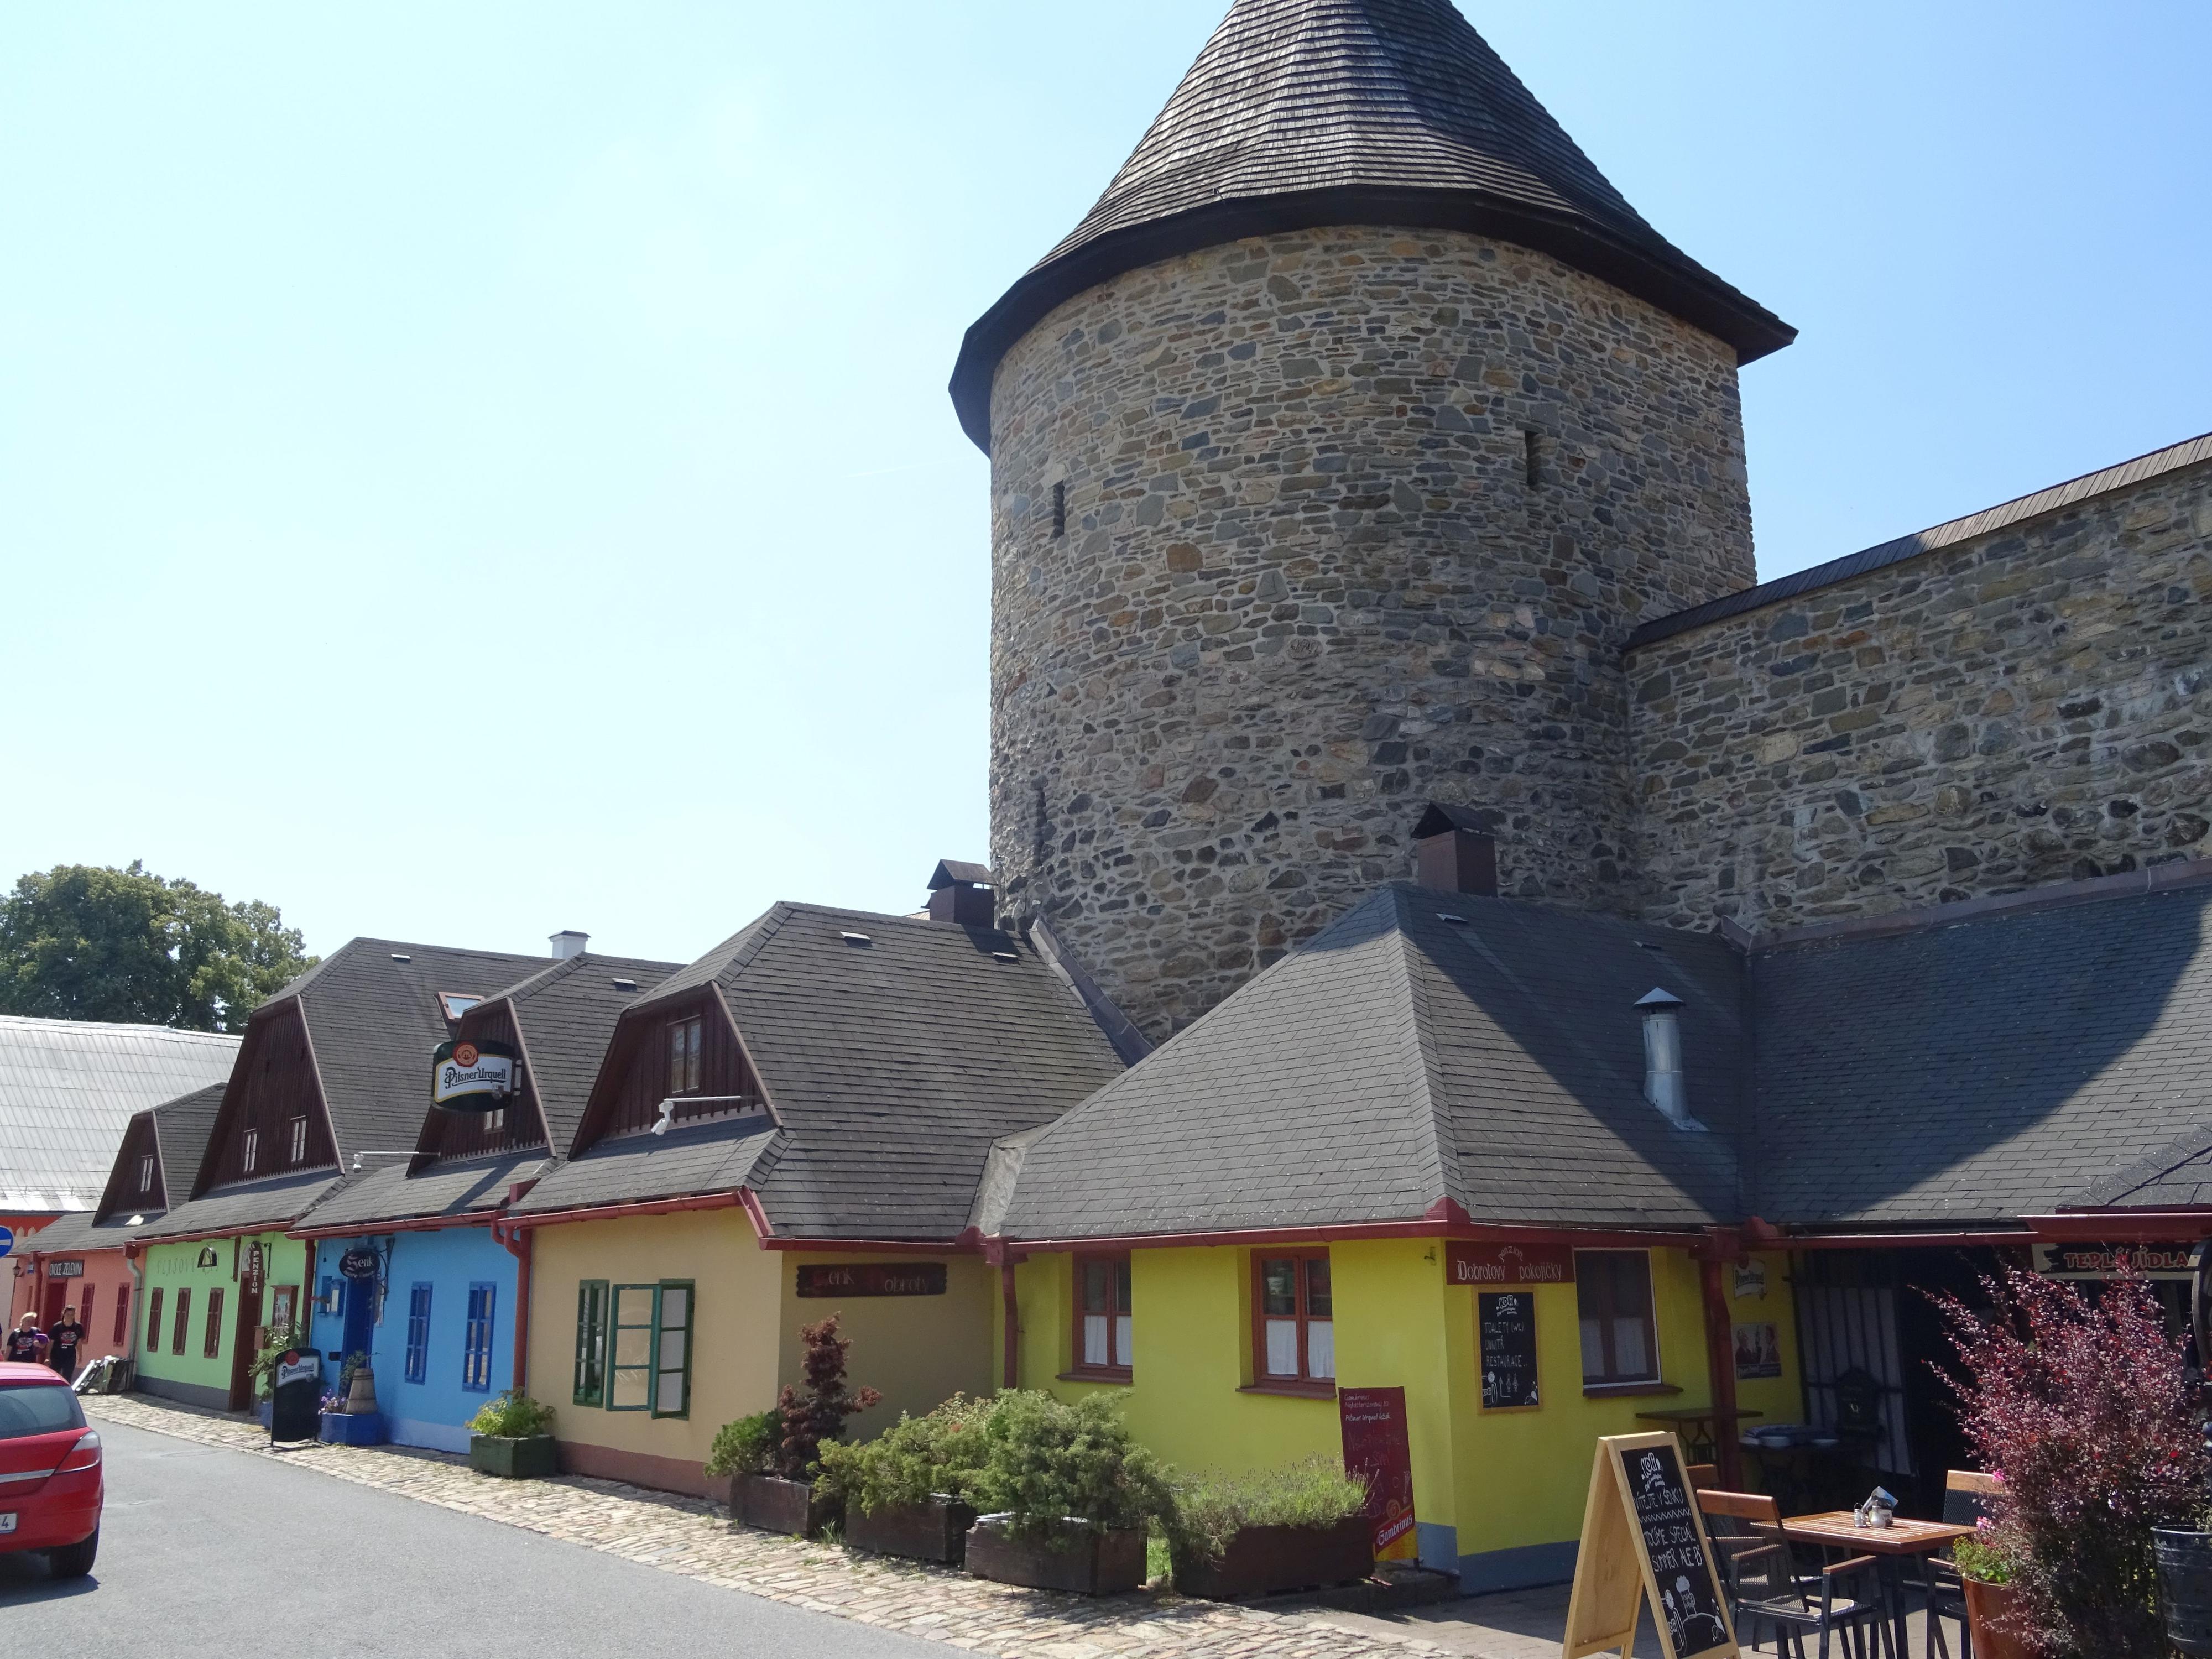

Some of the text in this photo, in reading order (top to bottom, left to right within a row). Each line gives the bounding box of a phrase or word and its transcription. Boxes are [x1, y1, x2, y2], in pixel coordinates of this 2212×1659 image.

[444, 1066, 507, 1089] Pilsner Urquell
[1498, 1246, 1524, 1262] penzion
[2131, 1246, 2188, 1269] JÍDLA
[49, 1263, 62, 1276] OVOCE
[1378, 1514, 1413, 1546] Gambrinus
[1652, 1548, 1679, 1572] SUMMER
[1679, 1547, 1694, 1566] ALE
